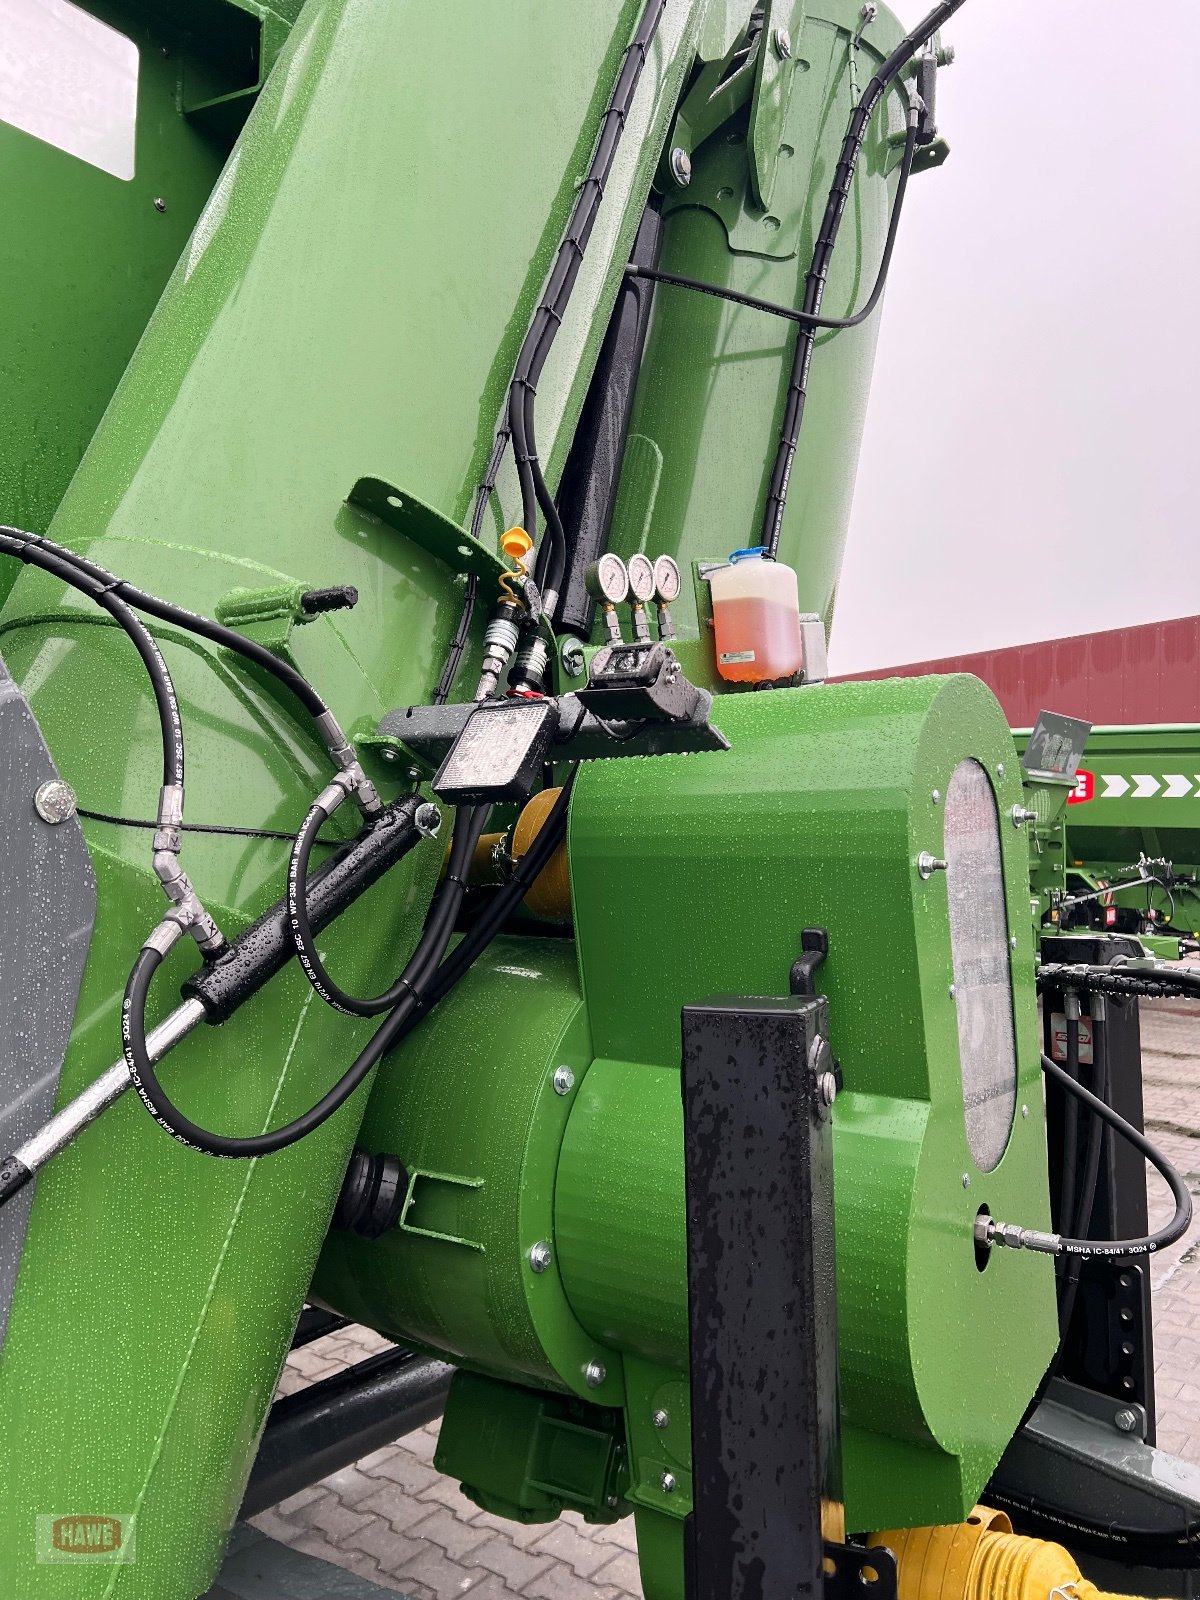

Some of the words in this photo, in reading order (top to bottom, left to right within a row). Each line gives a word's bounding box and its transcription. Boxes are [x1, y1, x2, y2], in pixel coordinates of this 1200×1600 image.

[163, 675, 174, 693] BAR
[169, 696, 178, 711] 330
[171, 712, 180, 725] WP
[175, 728, 182, 739] 10
[175, 764, 183, 779] 857
[294, 830, 305, 855] MSHA
[290, 858, 299, 878] BAR
[290, 901, 297, 915] WP
[291, 919, 299, 929] 10
[294, 934, 305, 951] 2SC
[300, 954, 311, 968] 857
[306, 968, 317, 980] EN
[138, 1088, 158, 1115] MSHA
[156, 1117, 175, 1134] BAR
[1066, 1245, 1091, 1254] MSHA
[1128, 1245, 1147, 1254] 3Q24
